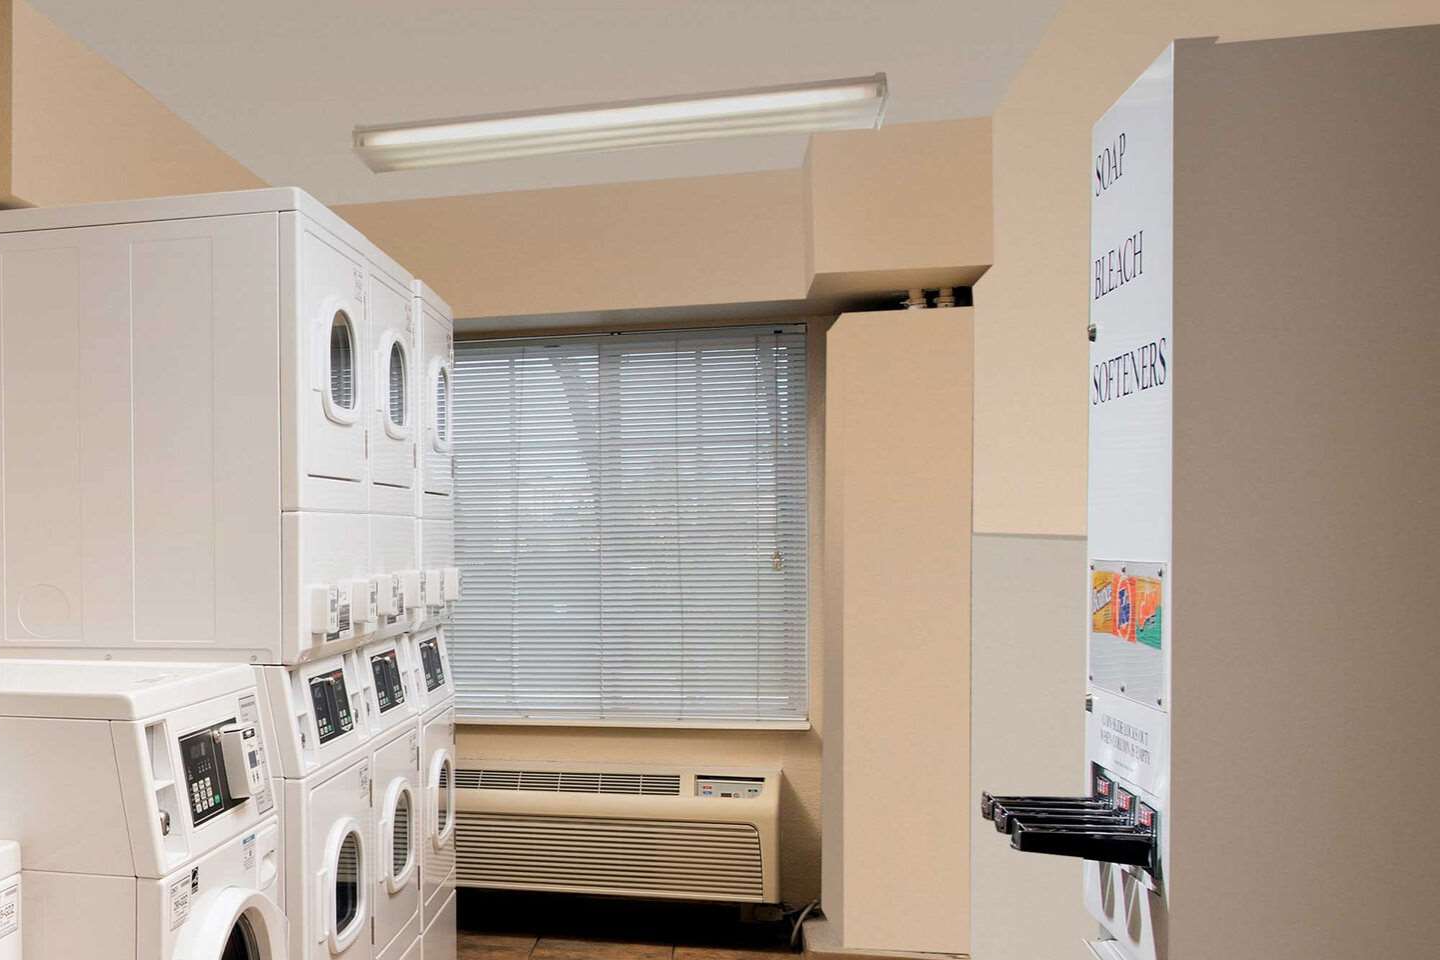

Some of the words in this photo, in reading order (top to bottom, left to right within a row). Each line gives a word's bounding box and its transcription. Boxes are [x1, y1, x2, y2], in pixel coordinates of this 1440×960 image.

[1095, 132, 1126, 197] SOAP
[1095, 230, 1143, 300] BLEACH
[1092, 337, 1167, 406] SOFTENERS
